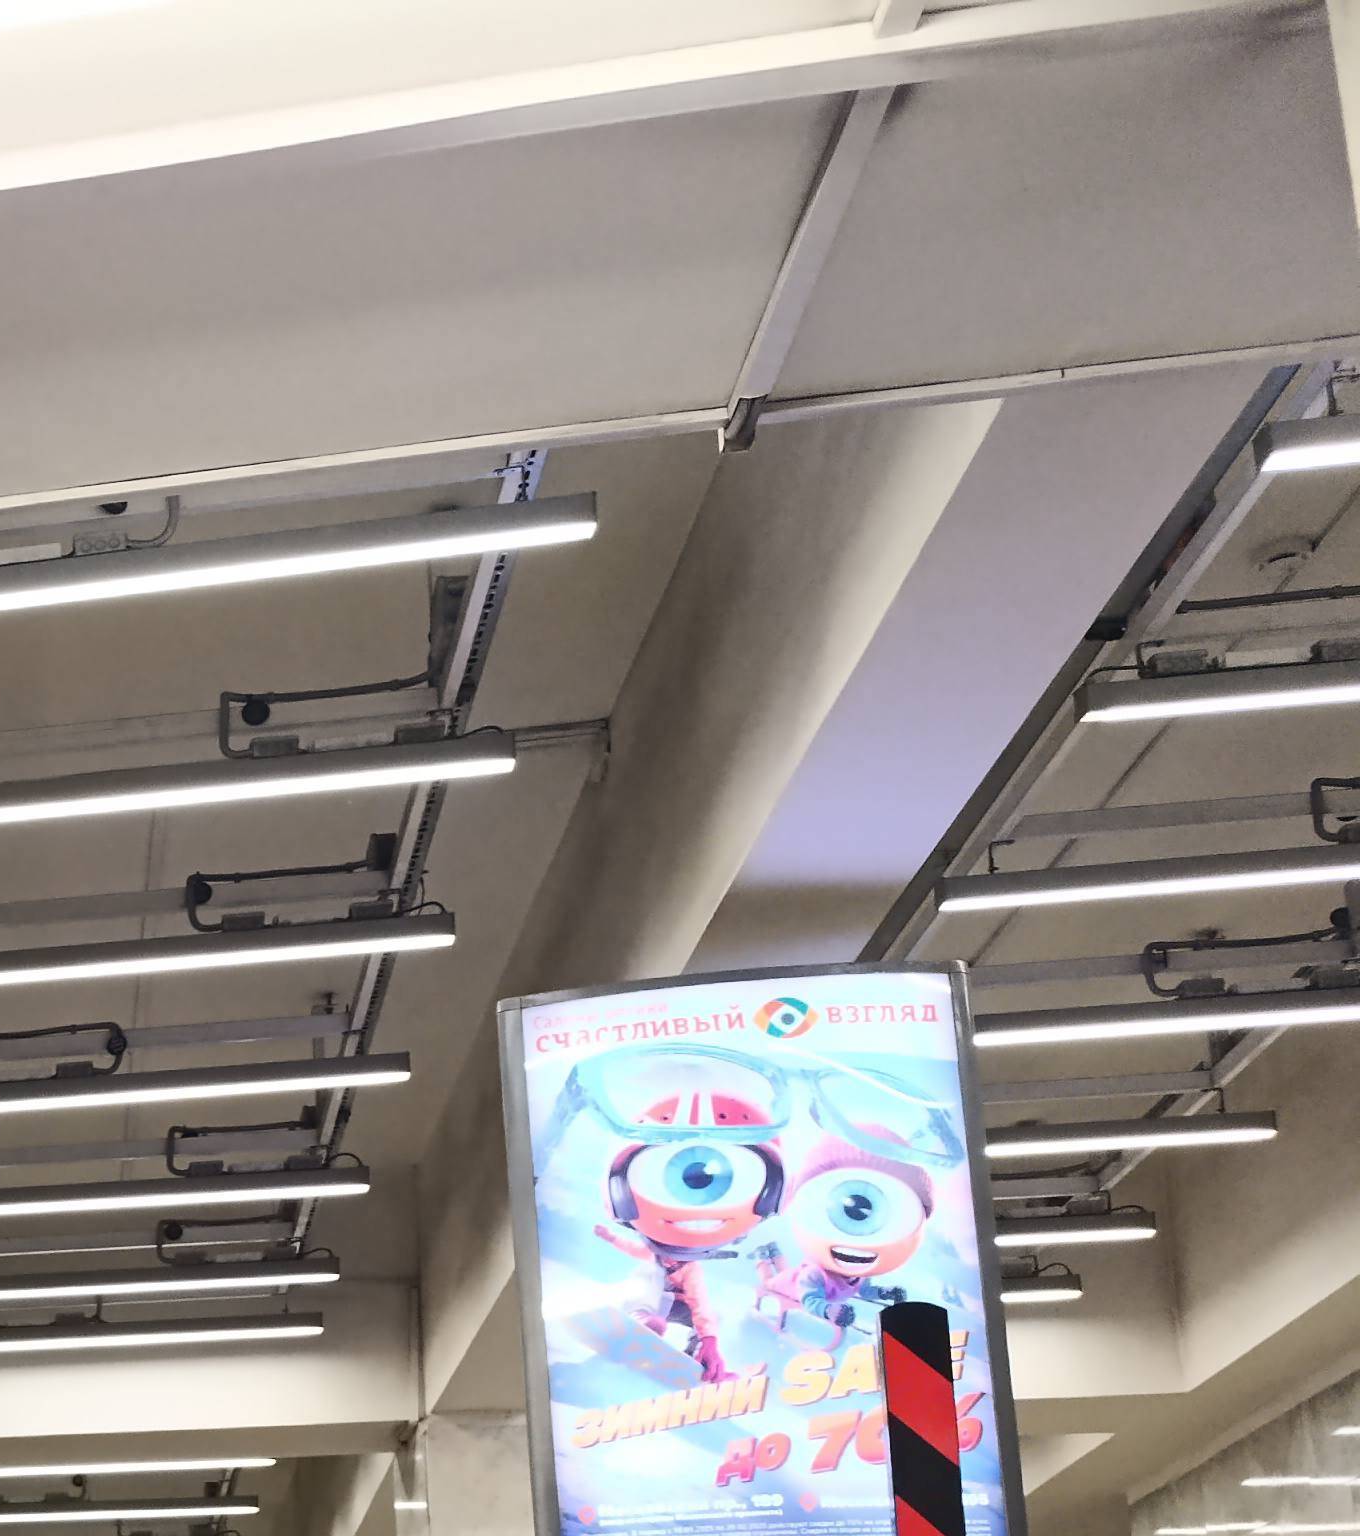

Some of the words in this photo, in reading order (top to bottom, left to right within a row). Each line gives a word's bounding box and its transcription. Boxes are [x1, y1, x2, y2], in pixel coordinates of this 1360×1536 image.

[535, 1004, 746, 1053] СЧАСТЛИВЫЙ
[826, 1004, 940, 1024] ВЗГЛЯД
[571, 1361, 770, 1448] ЗИМНИЙ
